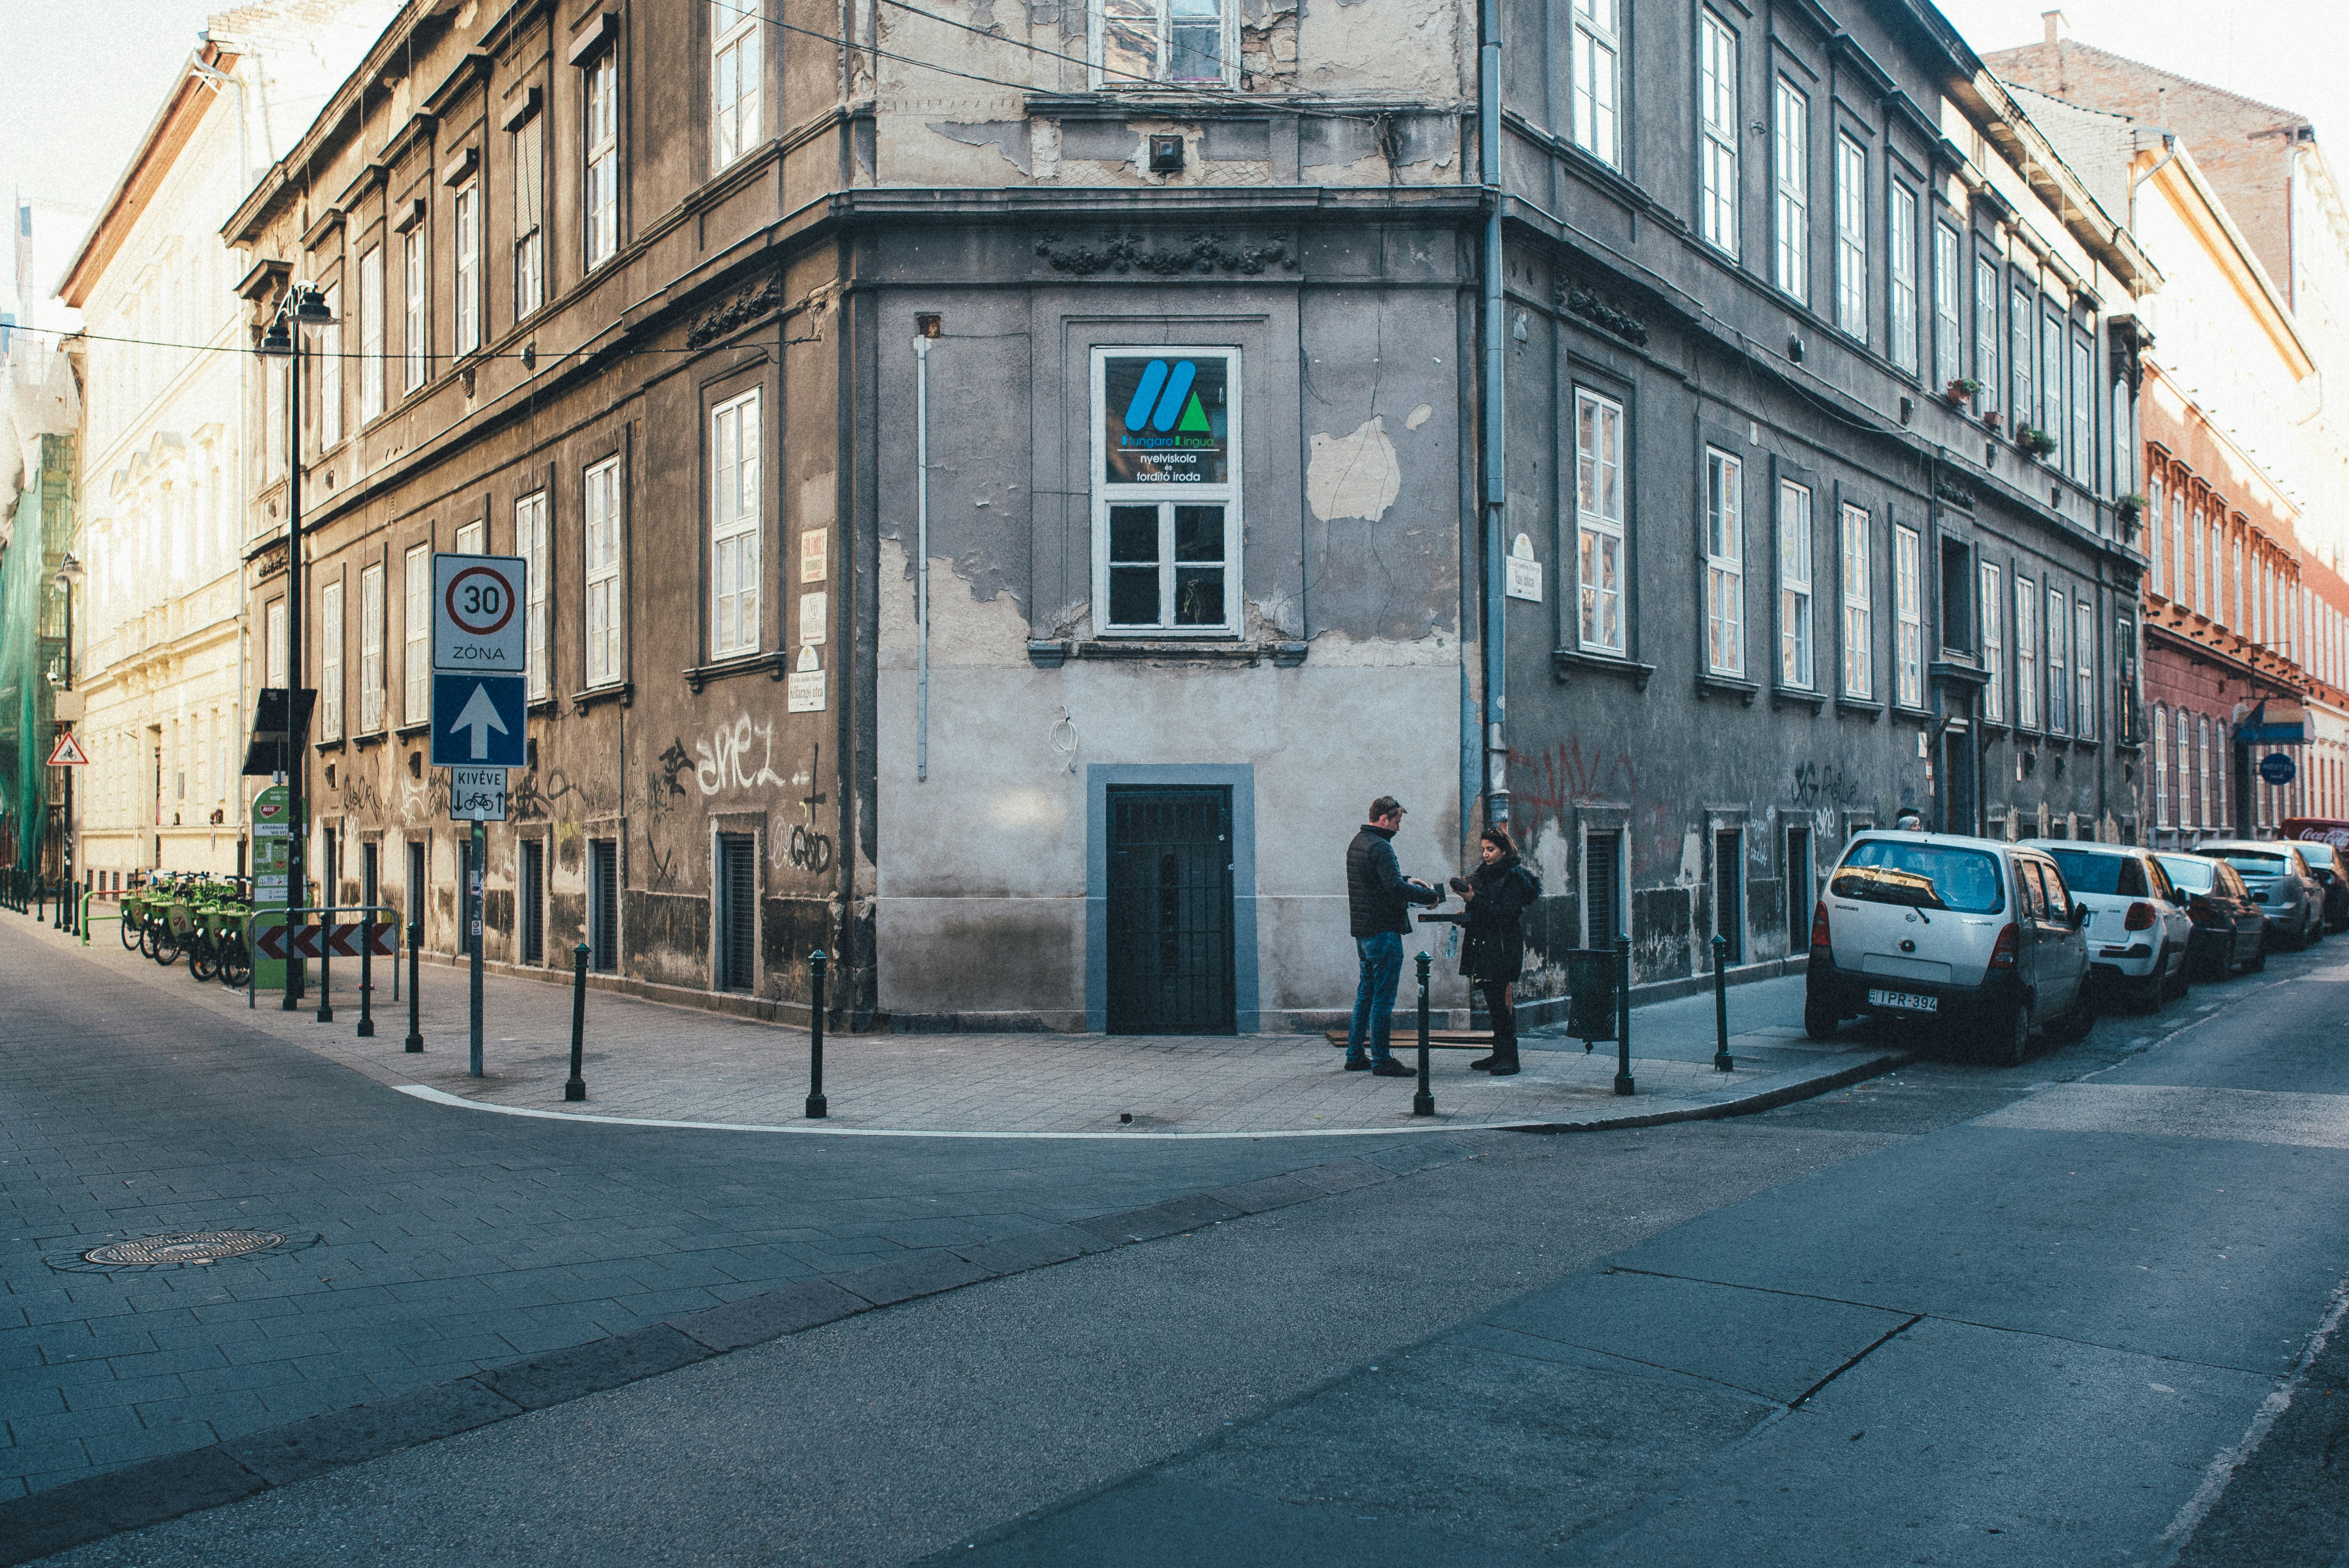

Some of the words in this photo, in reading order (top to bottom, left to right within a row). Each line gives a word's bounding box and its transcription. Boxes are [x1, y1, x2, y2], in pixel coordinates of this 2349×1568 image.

[1140, 454, 1196, 463] nyelviskola
[1137, 472, 1170, 481] fordító
[1173, 472, 1200, 481] iroda
[1514, 570, 1523, 585] Vas
[1524, 573, 1534, 588] utca
[464, 586, 499, 614] 30
[453, 644, 505, 660] ZÓNA
[790, 684, 811, 701] Kőfaragó
[812, 685, 823, 698] utca
[458, 770, 501, 785] KIVÉVE
[1881, 991, 1936, 1010] IPR-394
